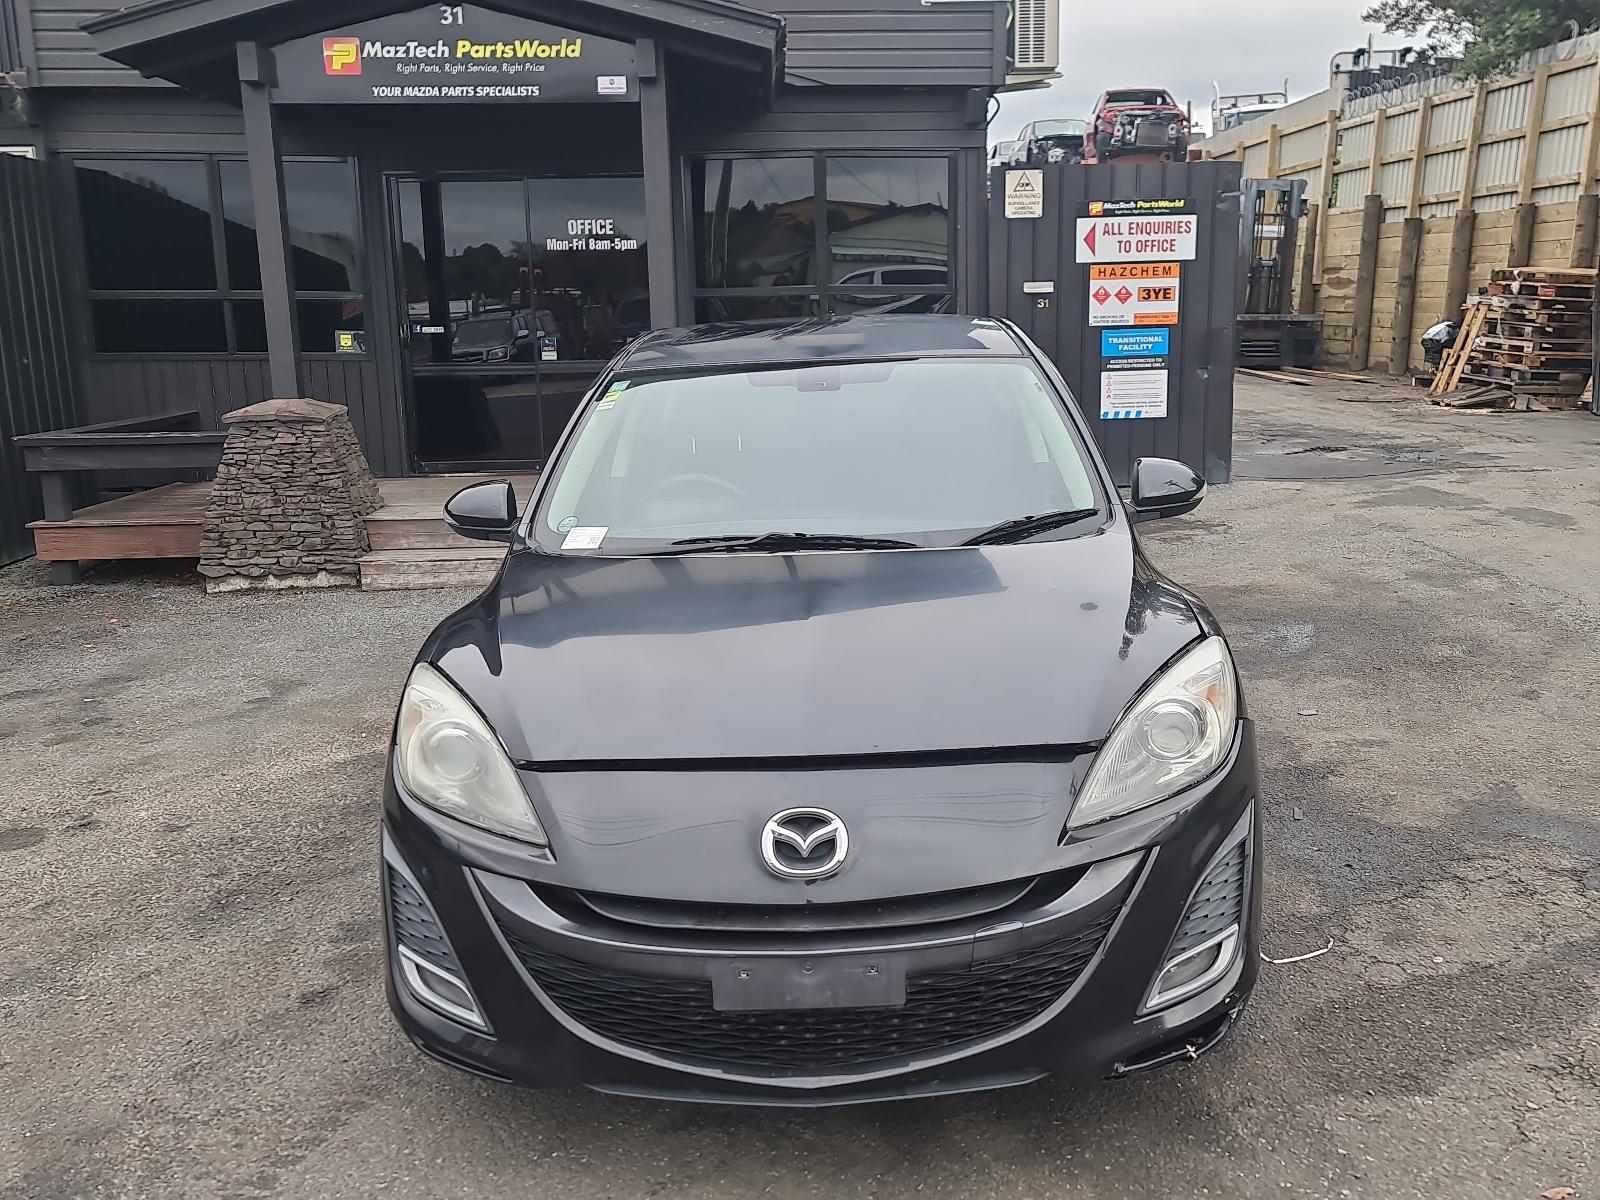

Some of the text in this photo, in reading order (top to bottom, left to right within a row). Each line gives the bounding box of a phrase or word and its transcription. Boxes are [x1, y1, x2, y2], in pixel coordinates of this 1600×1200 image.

[440, 6, 464, 25] 31
[362, 40, 449, 58] MazTech
[456, 38, 582, 58] PartsWorld
[396, 63, 545, 74] Right Parts, Right Service, Right Price
[372, 86, 540, 97] YOUR MAZDA PARTS SPECIALISTS
[1136, 200, 1185, 208] PartsWorld
[567, 219, 615, 235] OFFICE
[1102, 220, 1192, 236] ALL ENQUIRIES
[546, 238, 638, 251] Mon-Fri 8am-5pm
[1117, 239, 1177, 253] TO OFFICE
[1098, 266, 1172, 277] HAZCHEM
[1142, 288, 1171, 300] 3YE
[1037, 299, 1049, 308] 31
[1107, 336, 1163, 344] TRANSITIONAL
